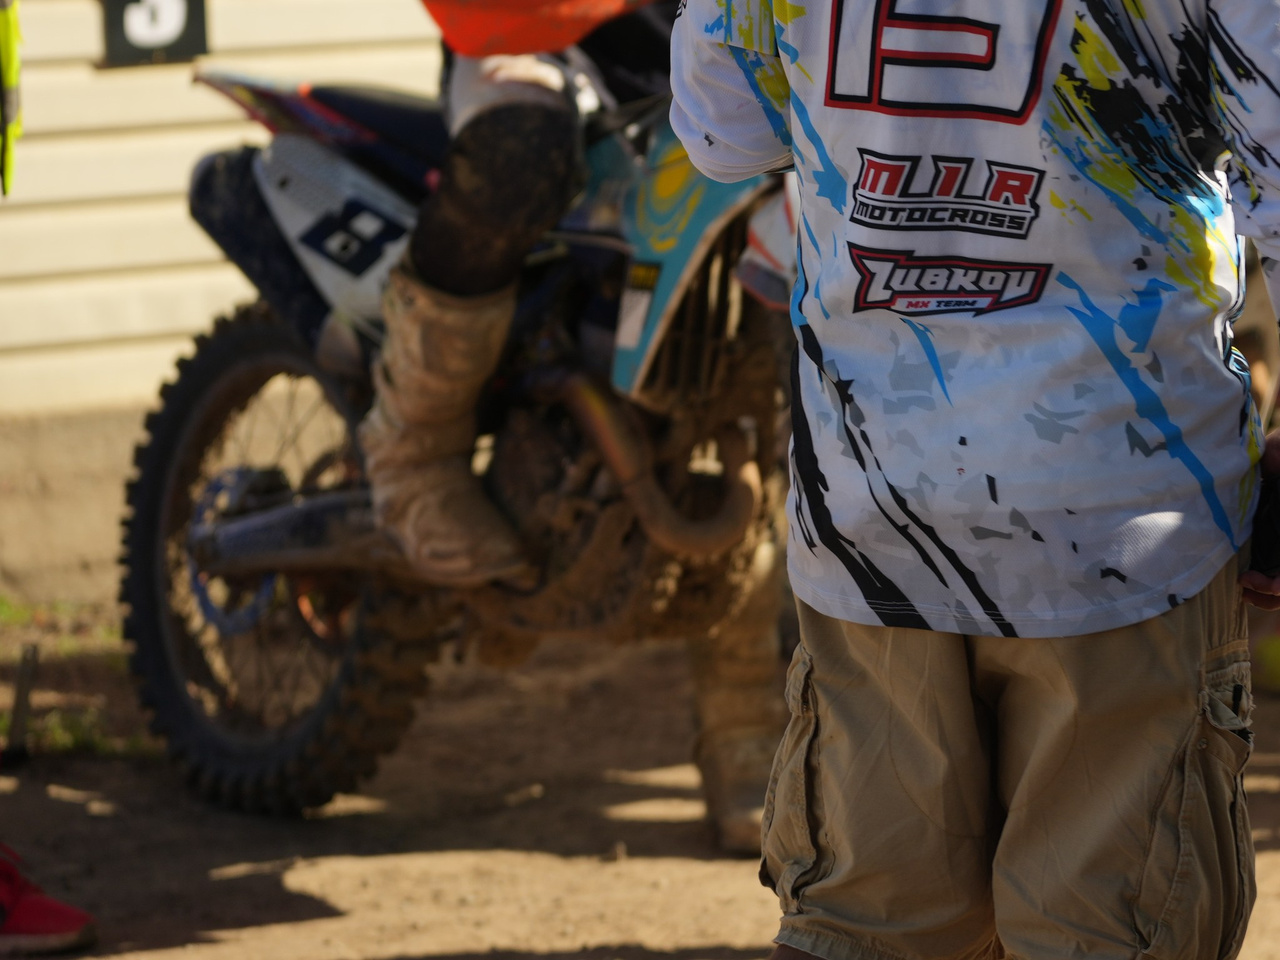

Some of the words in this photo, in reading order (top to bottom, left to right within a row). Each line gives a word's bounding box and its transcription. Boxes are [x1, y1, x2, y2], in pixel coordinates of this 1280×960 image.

[856, 206, 1027, 231] MOTOCROSS
[905, 300, 931, 309] MX
[935, 299, 978, 308] TEAM
